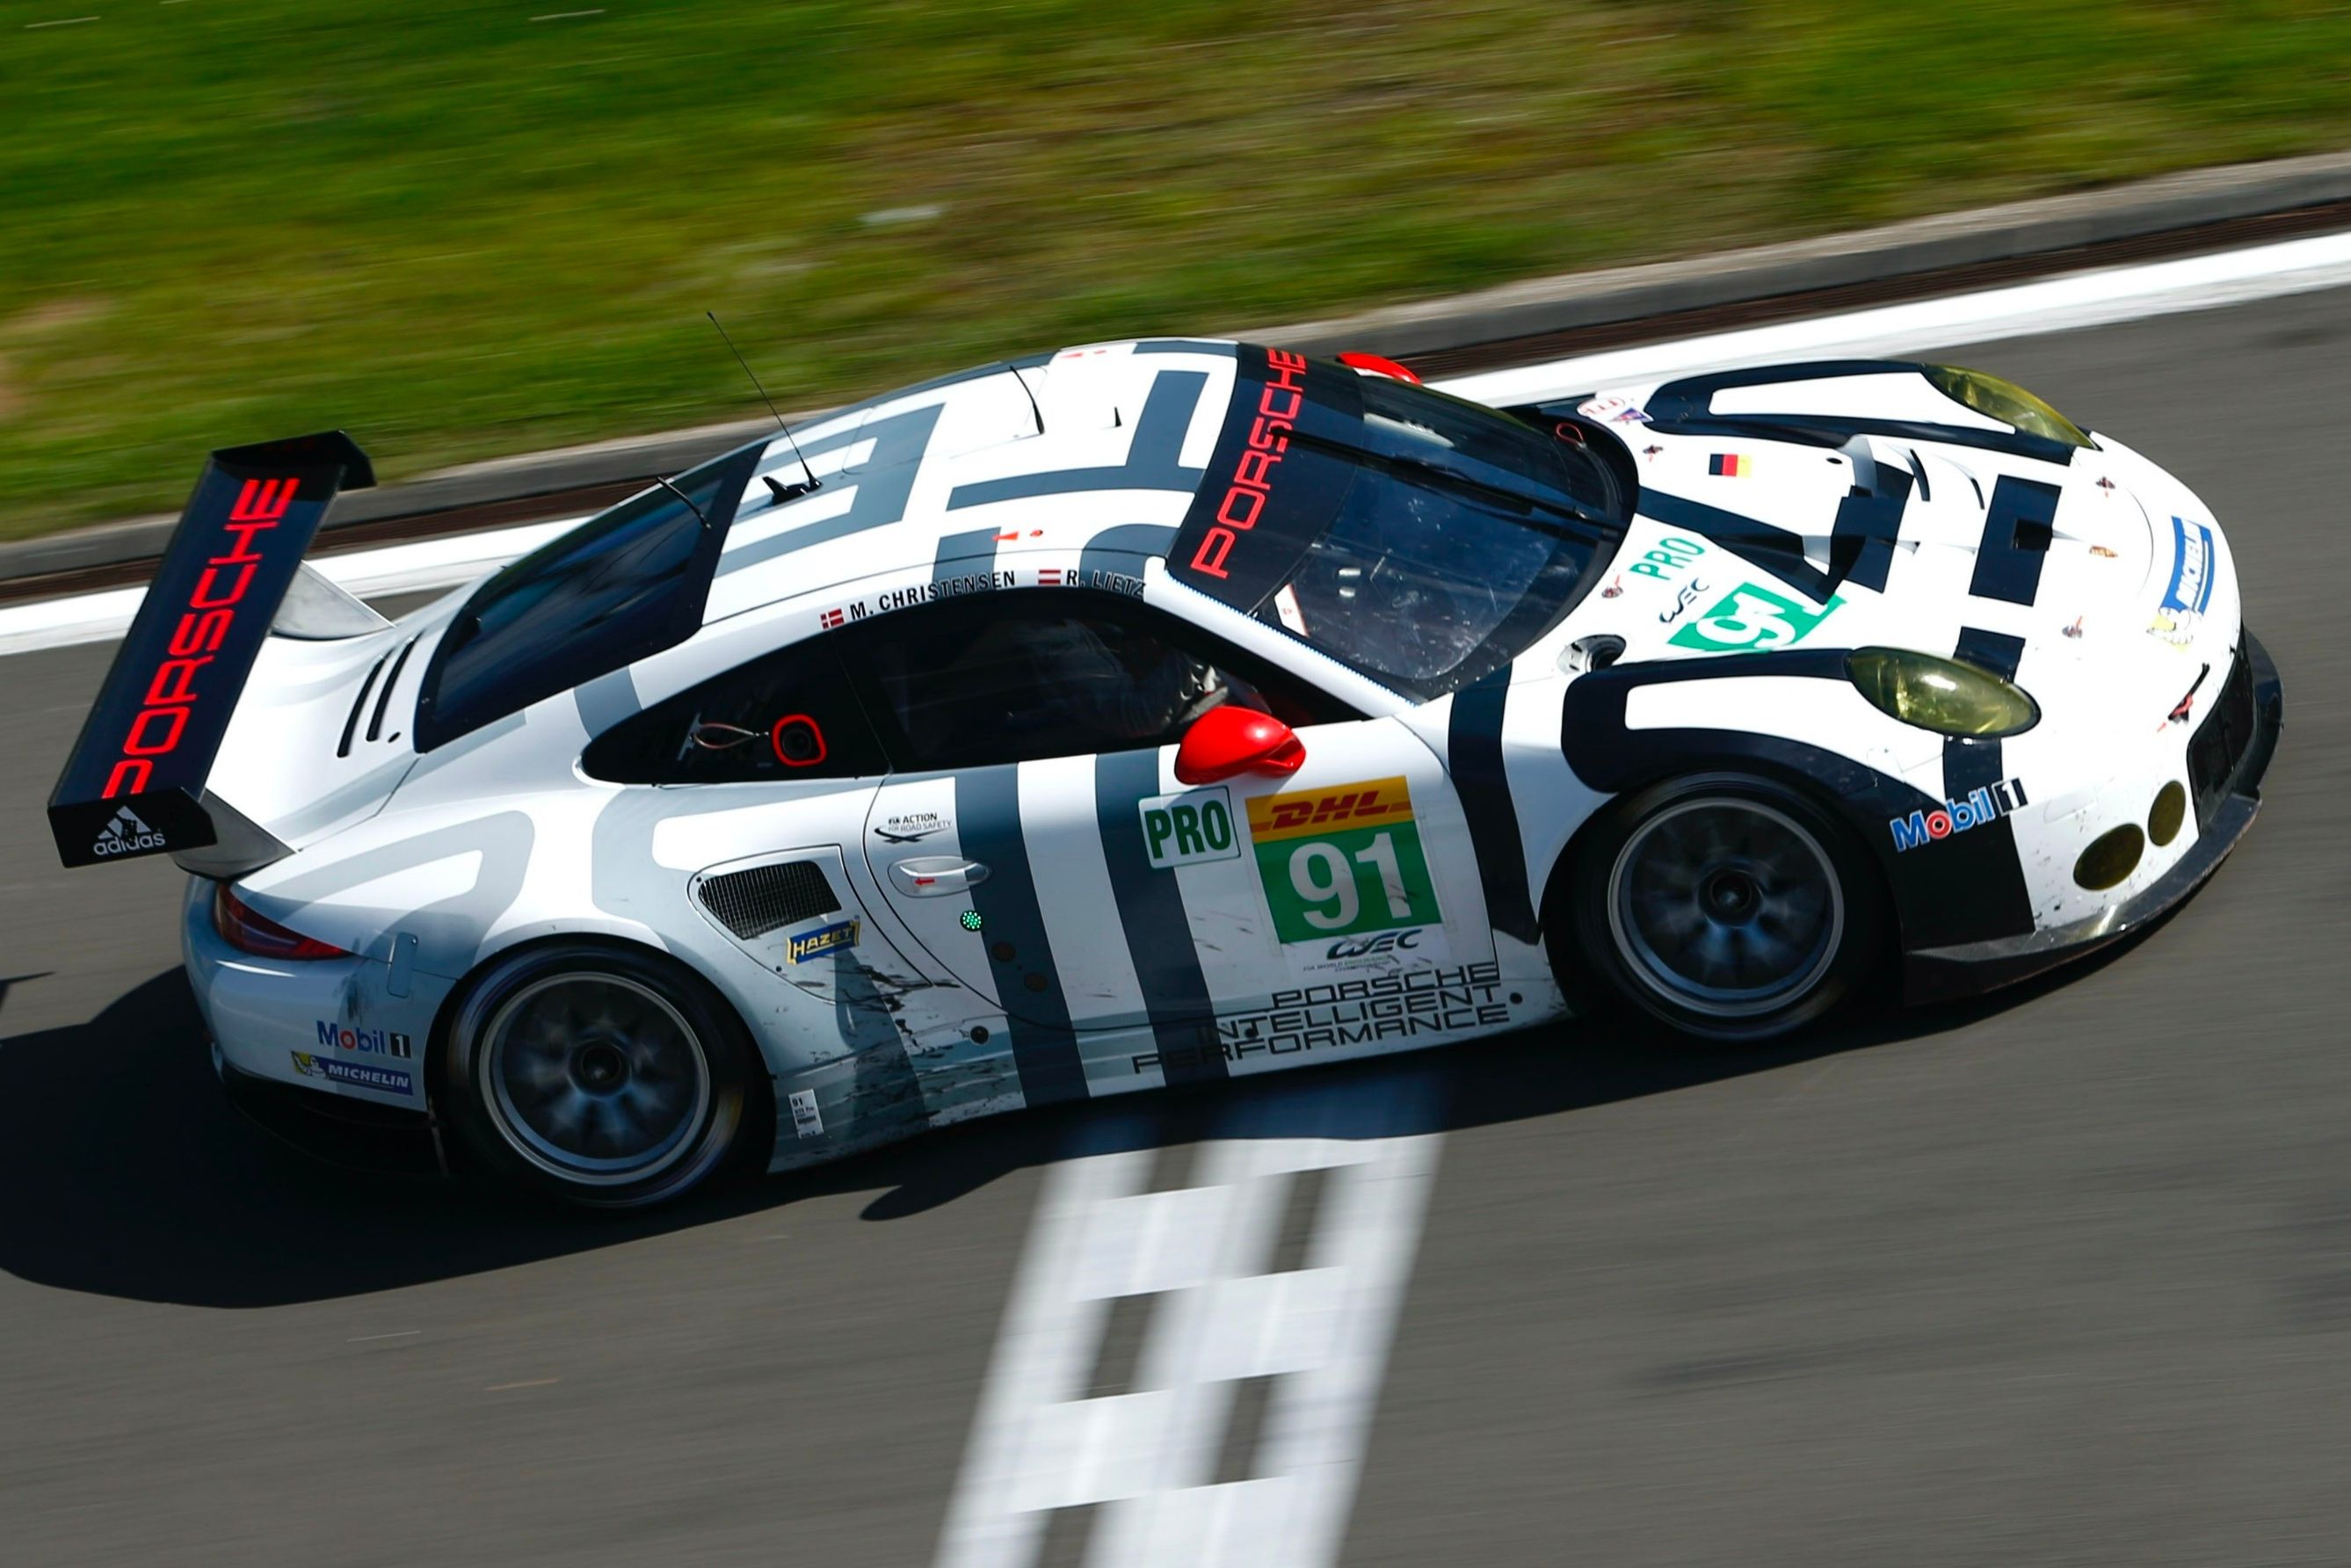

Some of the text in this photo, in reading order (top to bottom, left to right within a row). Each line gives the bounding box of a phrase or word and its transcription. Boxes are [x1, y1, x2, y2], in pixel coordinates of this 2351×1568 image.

[1190, 347, 1307, 580] PORSCHE
[1629, 537, 1705, 581] PRO
[2175, 518, 2203, 608] MICHELIN
[849, 570, 1016, 621] M. CHRISTENSEN
[1066, 569, 1146, 599] R. LIETZ
[1658, 577, 1710, 623] WEC
[101, 477, 301, 799] PORSCHE
[1696, 591, 1828, 649] 91
[901, 823, 922, 832] ROAD
[923, 820, 952, 831] SAFETY
[903, 812, 938, 824] ACTION
[1144, 798, 1231, 860] PRO
[1271, 790, 1390, 831] DHL
[1890, 785, 1997, 853] Mobil
[93, 832, 166, 856] adidas
[1288, 831, 1413, 930] 91
[793, 927, 853, 959] HAZET
[1326, 928, 1423, 960] WEC
[1272, 962, 1500, 1010] PORSCHE
[1196, 983, 1501, 1044] INTELLIGENT
[316, 1020, 386, 1055] Mobil
[328, 1063, 410, 1088] MICHELIN
